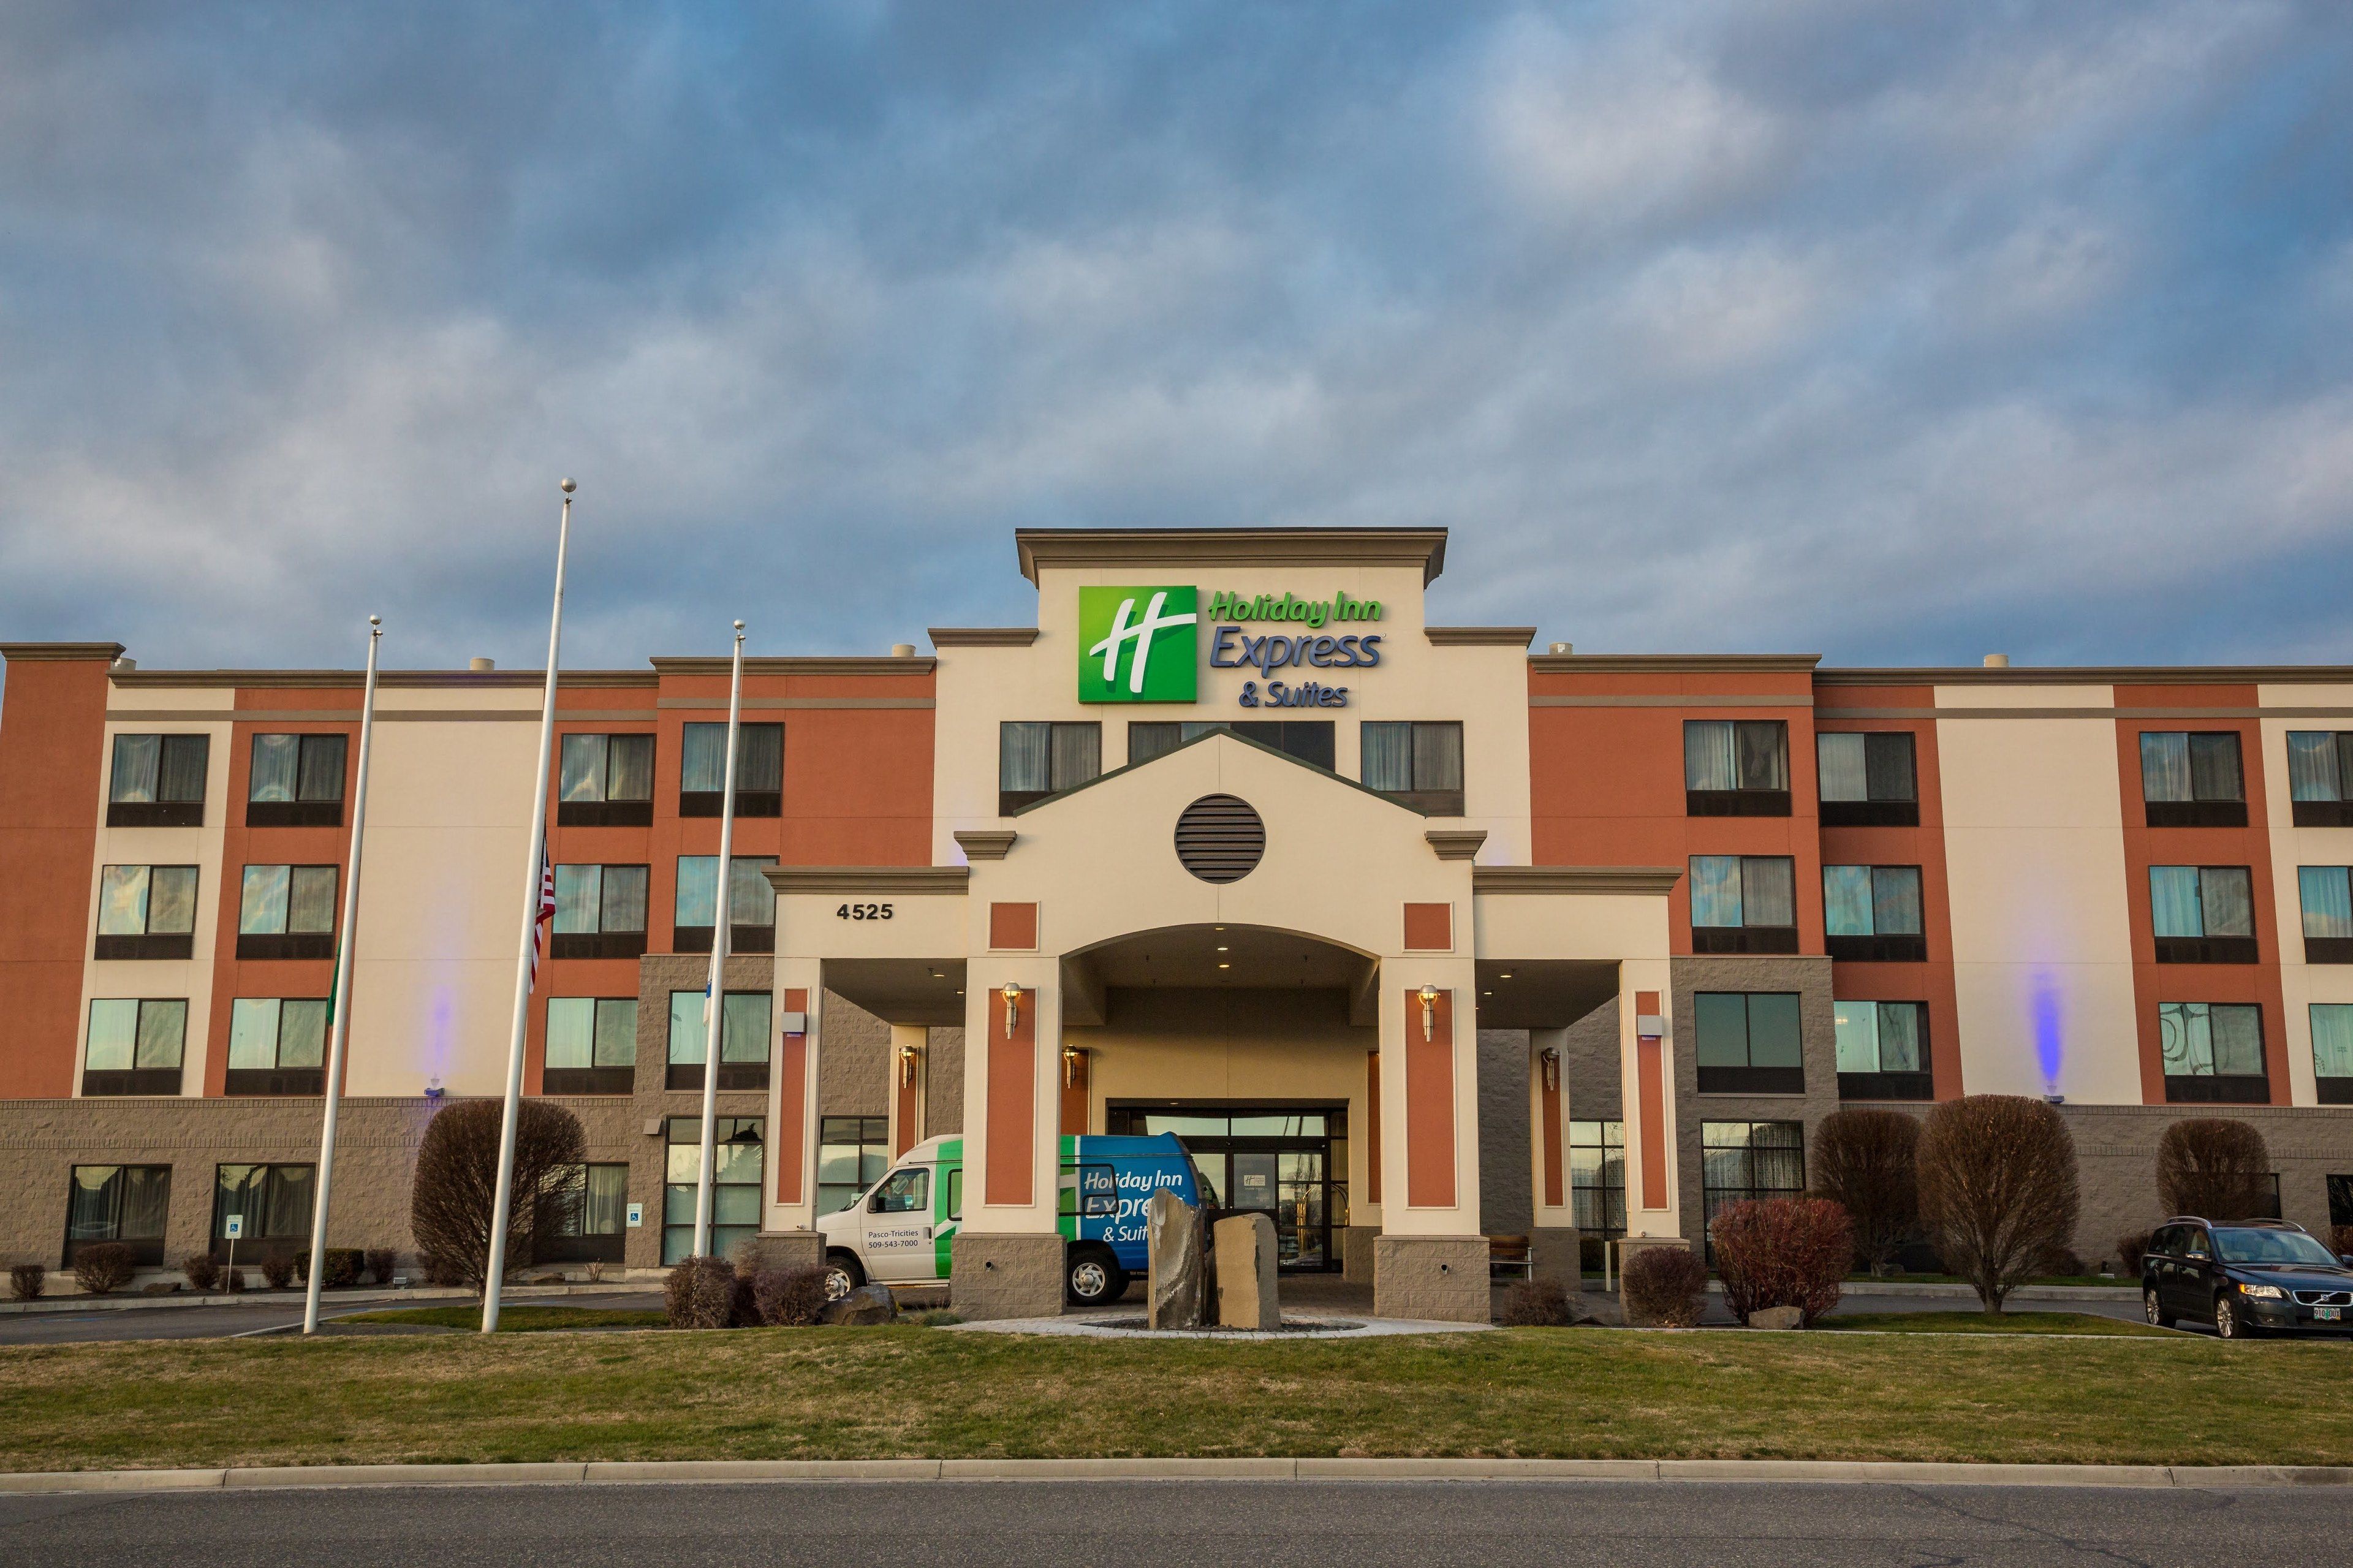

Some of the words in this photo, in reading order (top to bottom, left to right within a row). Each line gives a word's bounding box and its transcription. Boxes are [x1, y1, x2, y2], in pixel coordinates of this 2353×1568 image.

[1208, 591, 1328, 628] Holiday
[1333, 591, 1381, 621] Inn
[1210, 626, 1381, 679] Express
[1238, 681, 1259, 707] &
[1264, 681, 1348, 707] Suites
[836, 904, 893, 920] 4525
[1084, 1171, 1153, 1192] Holiday
[1154, 1169, 1183, 1187] Inn
[868, 1230, 919, 1238] Pasco-Tricities
[1102, 1226, 1115, 1242] &
[1118, 1225, 1149, 1241] Suit
[868, 1240, 918, 1248] 509-543-7000
